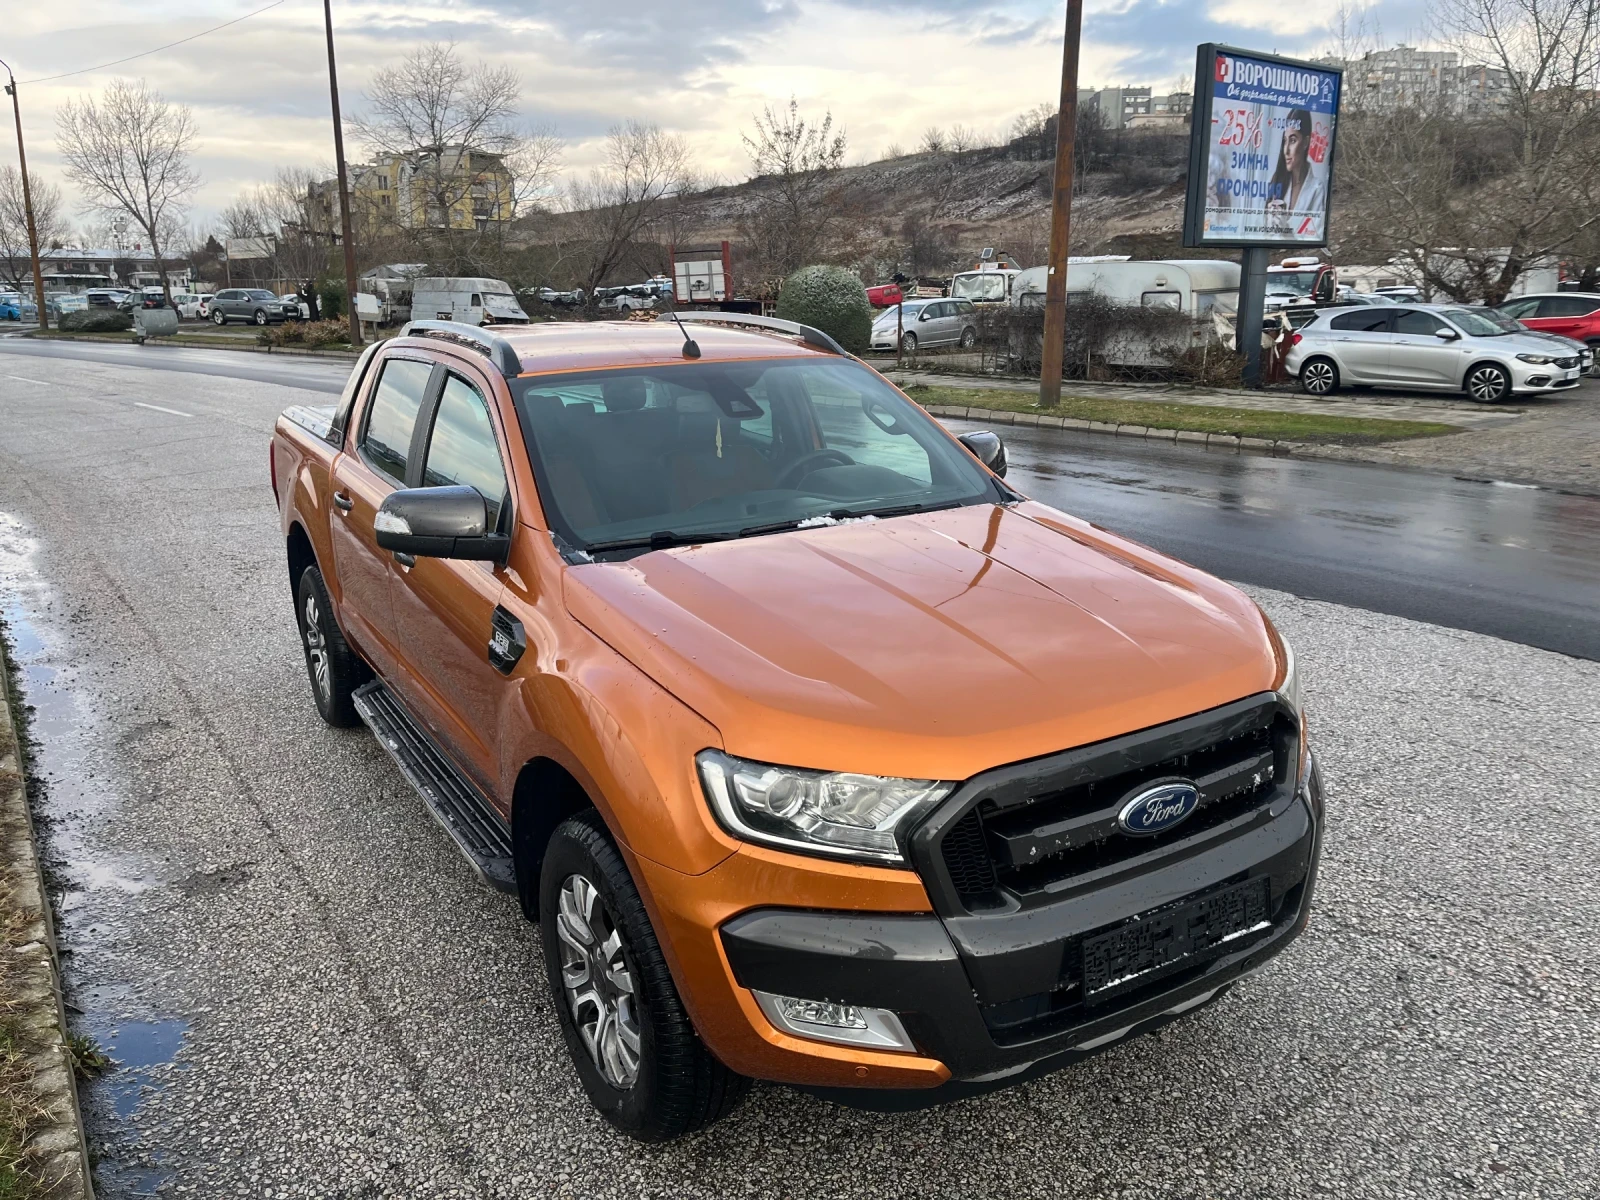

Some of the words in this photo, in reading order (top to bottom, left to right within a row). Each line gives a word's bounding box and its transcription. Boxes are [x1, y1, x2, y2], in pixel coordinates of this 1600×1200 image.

[1235, 61, 1319, 96] ВОРОШИЛОВ
[1227, 83, 1240, 97] От
[1277, 94, 1286, 106] до
[1211, 109, 1264, 149] -25%
[1231, 151, 1269, 171] ЗИМНА
[1216, 178, 1283, 201] ПРОМОЦИЯ
[1142, 794, 1185, 826] Ford
